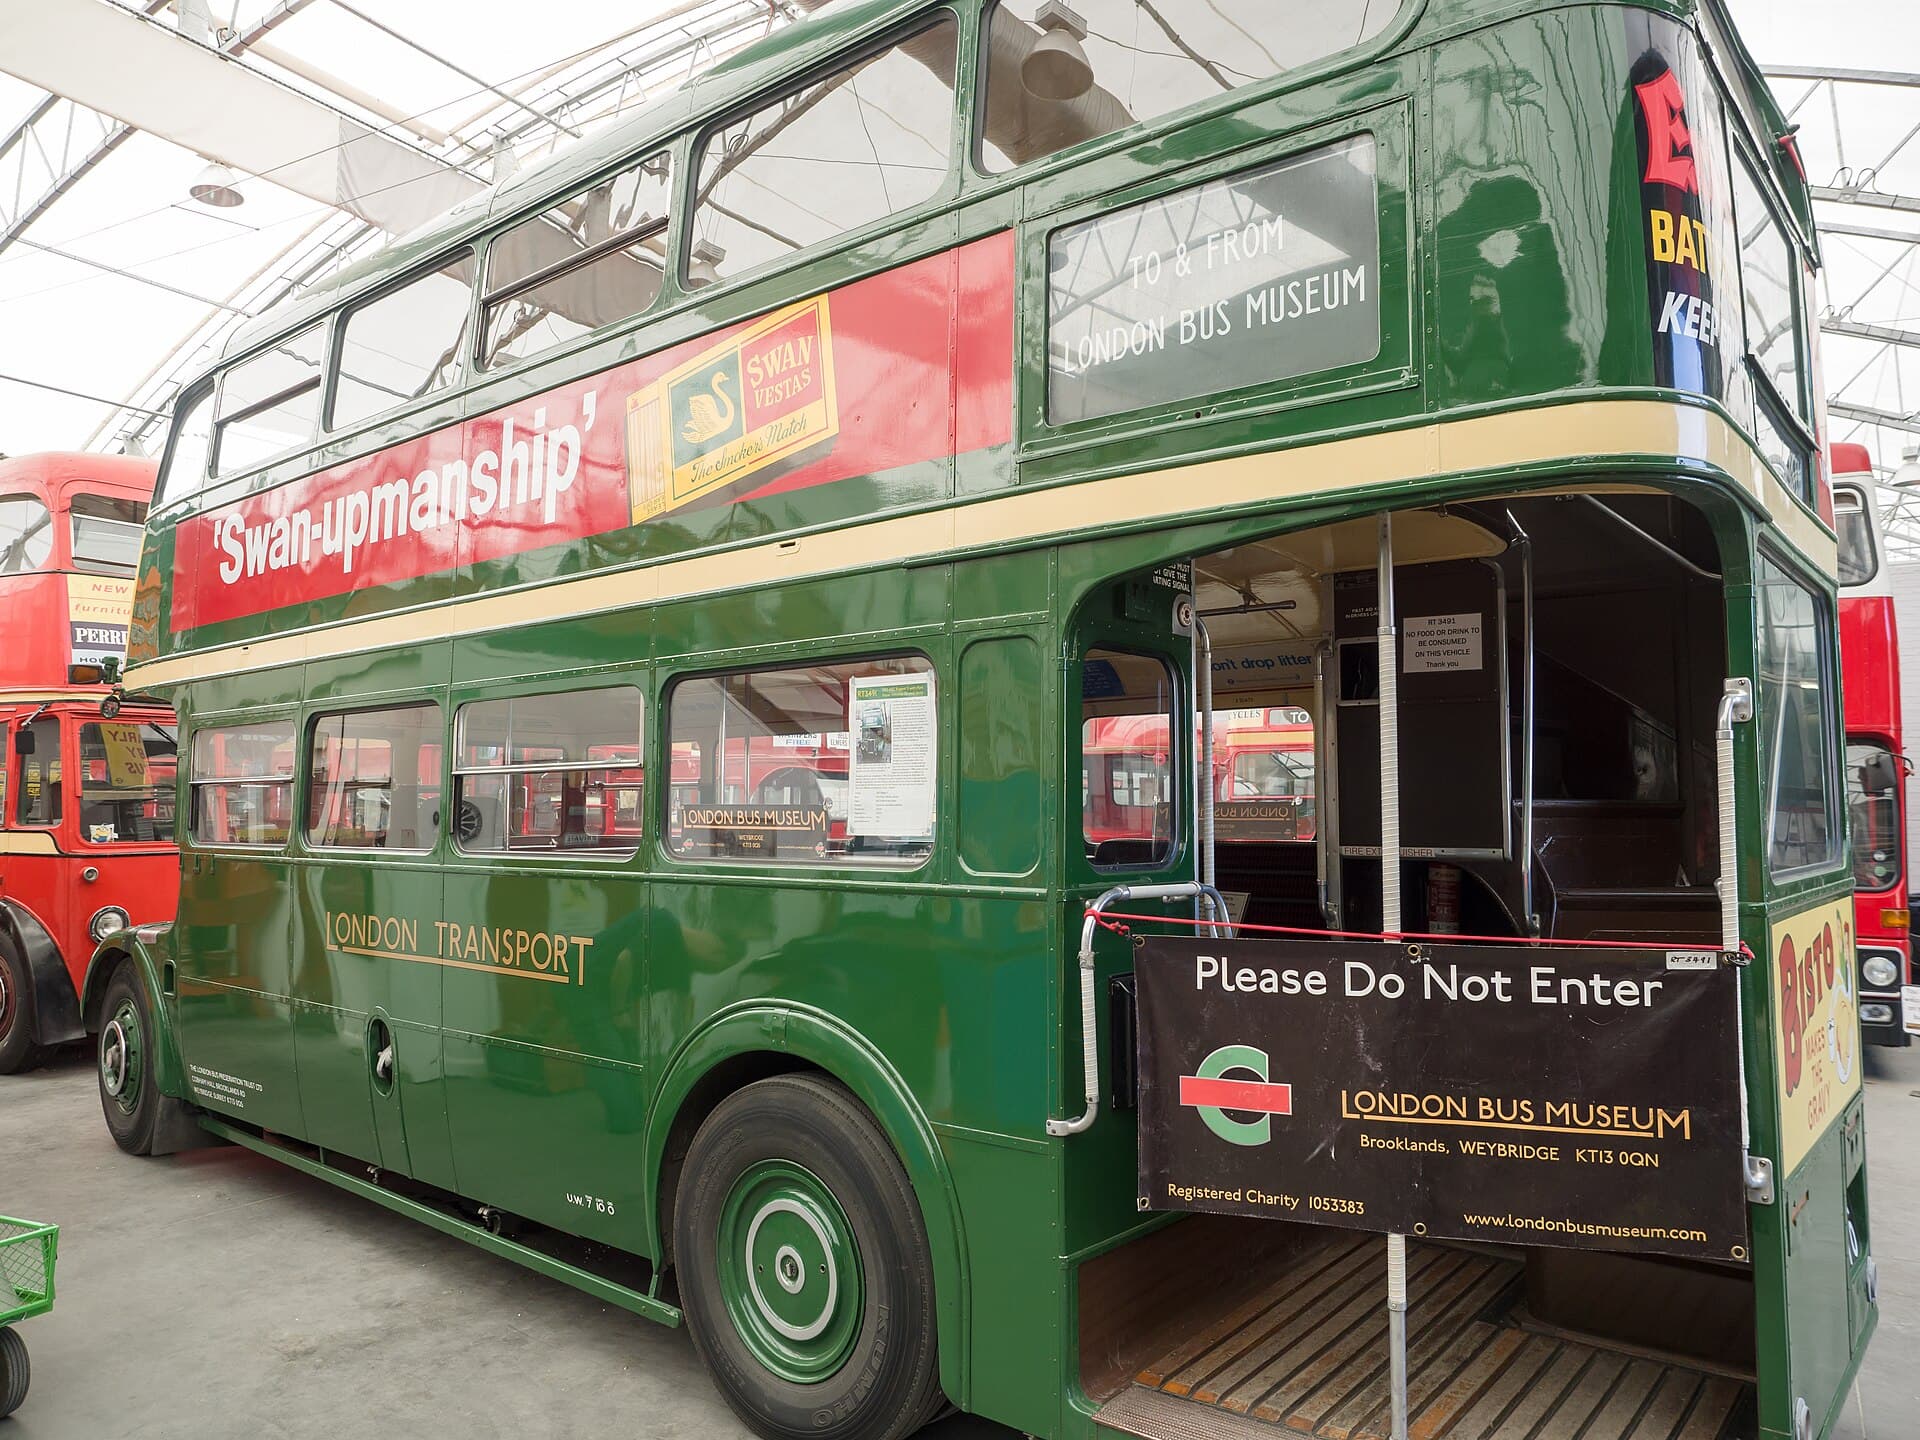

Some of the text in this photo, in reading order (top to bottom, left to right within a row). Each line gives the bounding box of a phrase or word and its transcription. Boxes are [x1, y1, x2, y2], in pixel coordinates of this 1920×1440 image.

[1128, 214, 1285, 289] TO & FROM
[1064, 264, 1365, 373] LONDON BUS MUSEUM
[747, 335, 814, 389] SWAN
[753, 367, 812, 409] VESTAS
[691, 461, 712, 483] The
[767, 412, 807, 448] Match
[92, 583, 128, 594] NEW
[1177, 571, 1187, 582] THE
[1438, 617, 1456, 625] 3491
[1428, 637, 1467, 646] CONSUMED
[1442, 648, 1471, 656] VEHICLE
[1211, 655, 1312, 671] on't drop litter
[1447, 661, 1459, 669] you
[682, 808, 826, 832] LONDON BUS MUSEUM
[1344, 847, 1363, 855] FIRE
[326, 911, 594, 986] LONDON TRANSPORT
[1196, 955, 1663, 1007] Please Do Not Enter
[1779, 921, 1834, 1098] BISTO
[1804, 1025, 1826, 1062] MAKES
[1811, 1061, 1823, 1083] THE
[1341, 1090, 1691, 1140] LONDON BUS MUSEUM
[1807, 1080, 1831, 1131] GRAVY
[1360, 1134, 1450, 1156] Brooklands,
[1459, 1140, 1560, 1162] WEYBRIDGE
[1575, 1148, 1614, 1165] KT13
[1168, 1183, 1365, 1215] Registered Charity 1053383
[1463, 1213, 1708, 1242] www.londonbusmuseum.com
[810, 1304, 891, 1429] KUMHO
